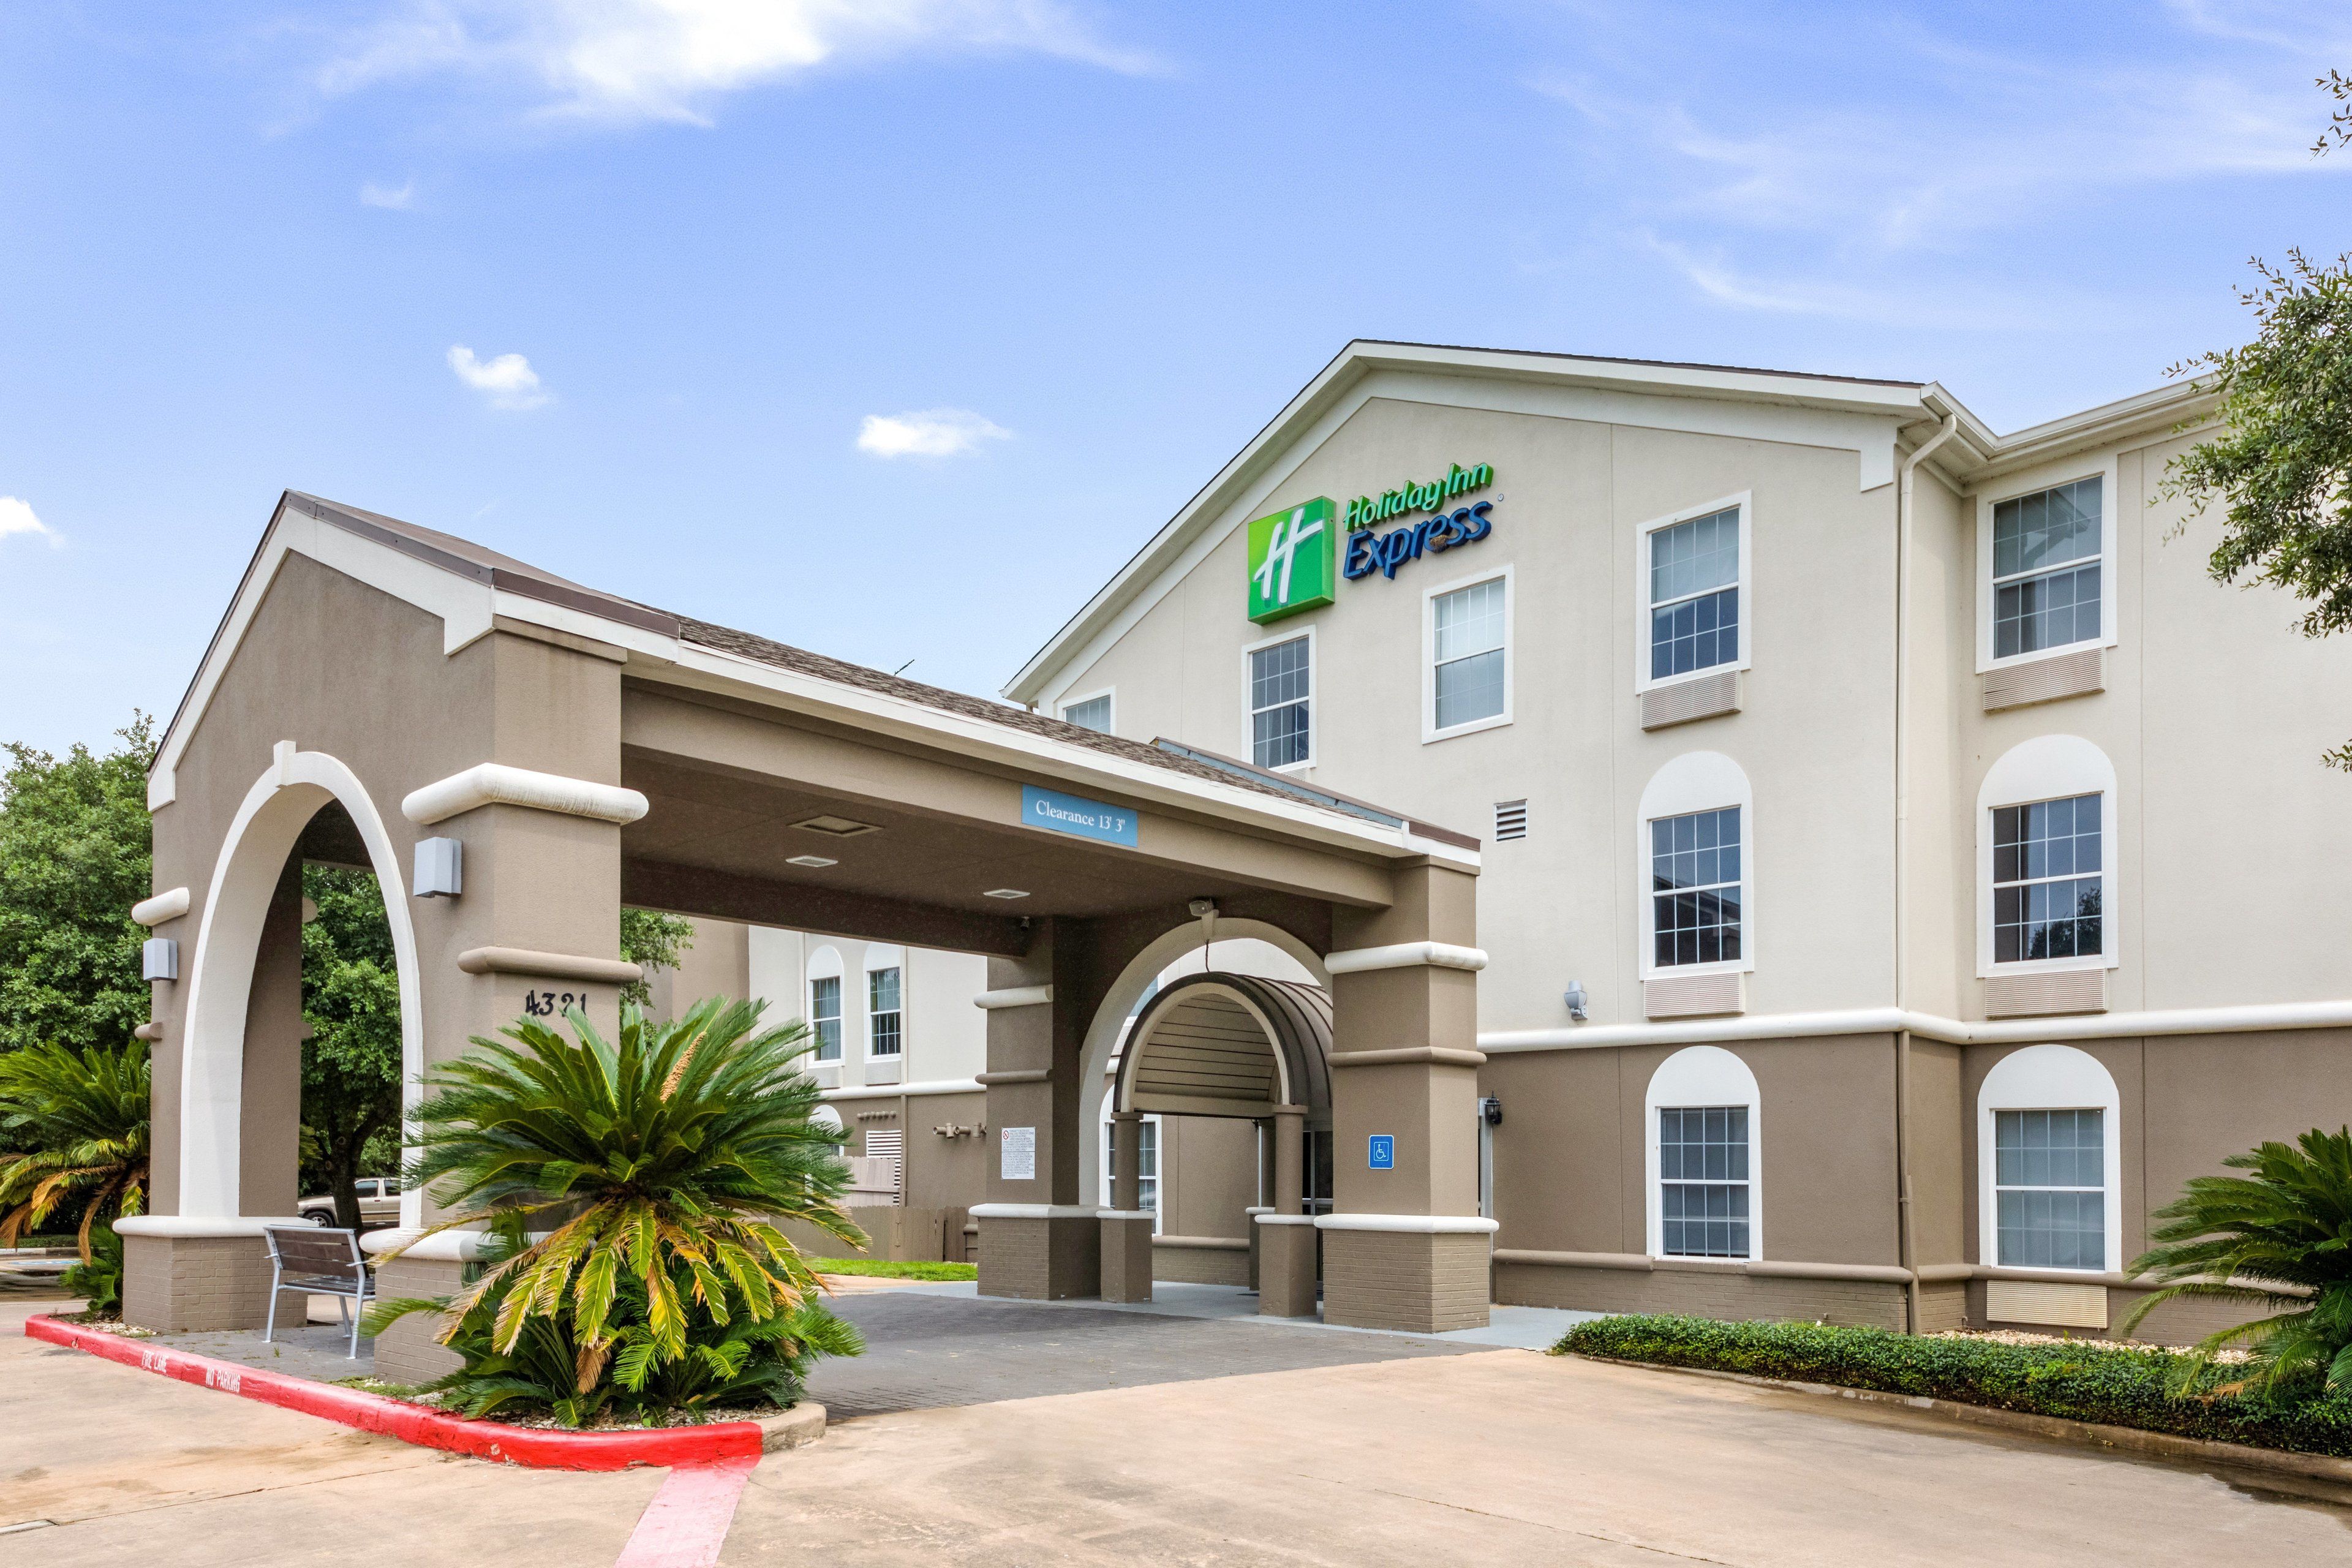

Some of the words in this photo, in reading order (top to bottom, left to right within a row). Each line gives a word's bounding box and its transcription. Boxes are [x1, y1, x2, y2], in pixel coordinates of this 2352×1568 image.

[1343, 480, 1446, 533] Holiday
[1444, 462, 1493, 500] Inn
[1343, 501, 1493, 581] Express
[1036, 800, 1095, 826] Clearance
[1099, 815, 1112, 829] 13'
[526, 990, 586, 1017] 4321
[141, 1350, 154, 1370] FIRE
[154, 1351, 168, 1373] LANE
[206, 1367, 215, 1386] NO
[217, 1370, 241, 1393] PARKING
